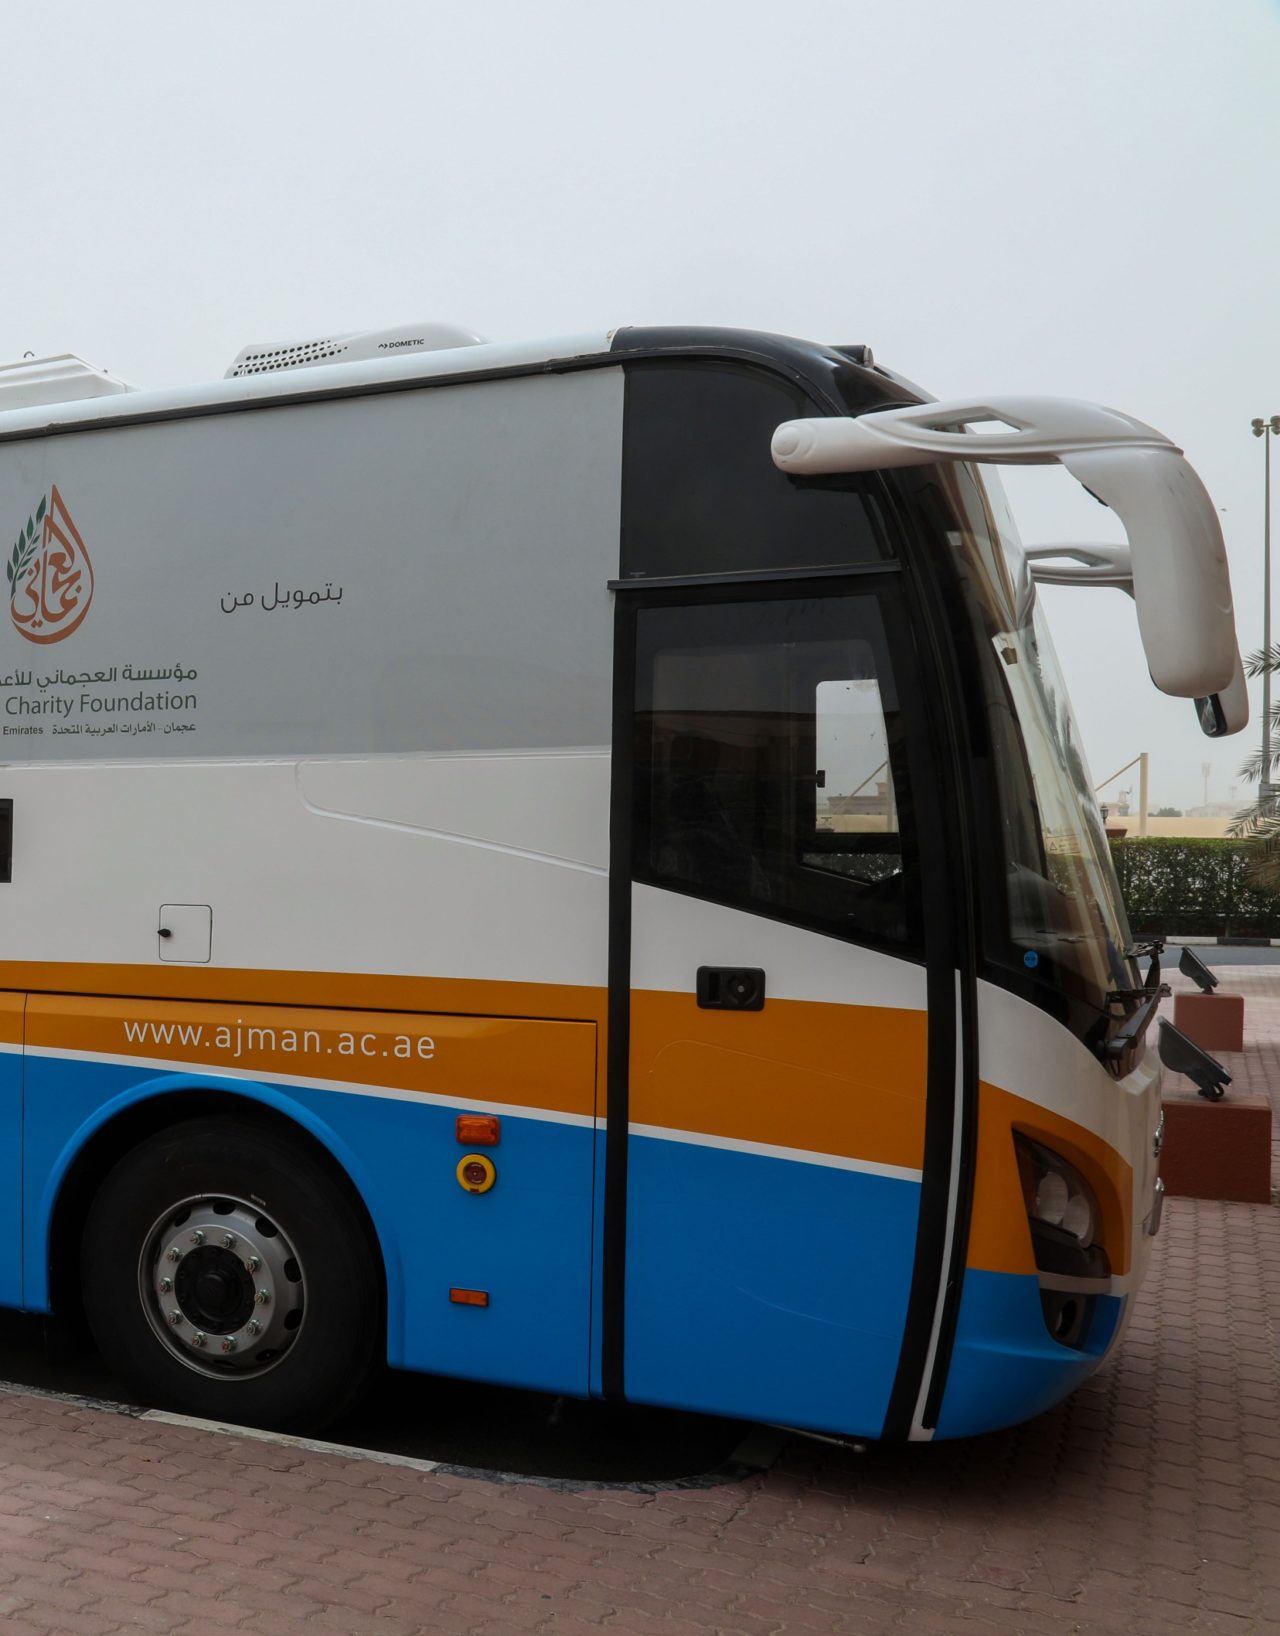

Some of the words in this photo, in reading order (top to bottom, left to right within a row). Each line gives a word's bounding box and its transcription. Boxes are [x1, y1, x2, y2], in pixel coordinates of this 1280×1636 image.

[389, 338, 424, 348] DOMETIC
[220, 591, 255, 613] من
[260, 581, 344, 611] بتمويل
[36, 666, 118, 693] العجماني
[122, 662, 198, 684] مؤسسة
[5, 695, 75, 719] Charity
[80, 691, 198, 714] Foundation
[3, 725, 44, 736] Emirates
[51, 724, 83, 736] المتحدة
[85, 723, 118, 736] العربية
[163, 721, 197, 735] عجمان
[123, 1018, 436, 1059] www.ajman.ac.ae
